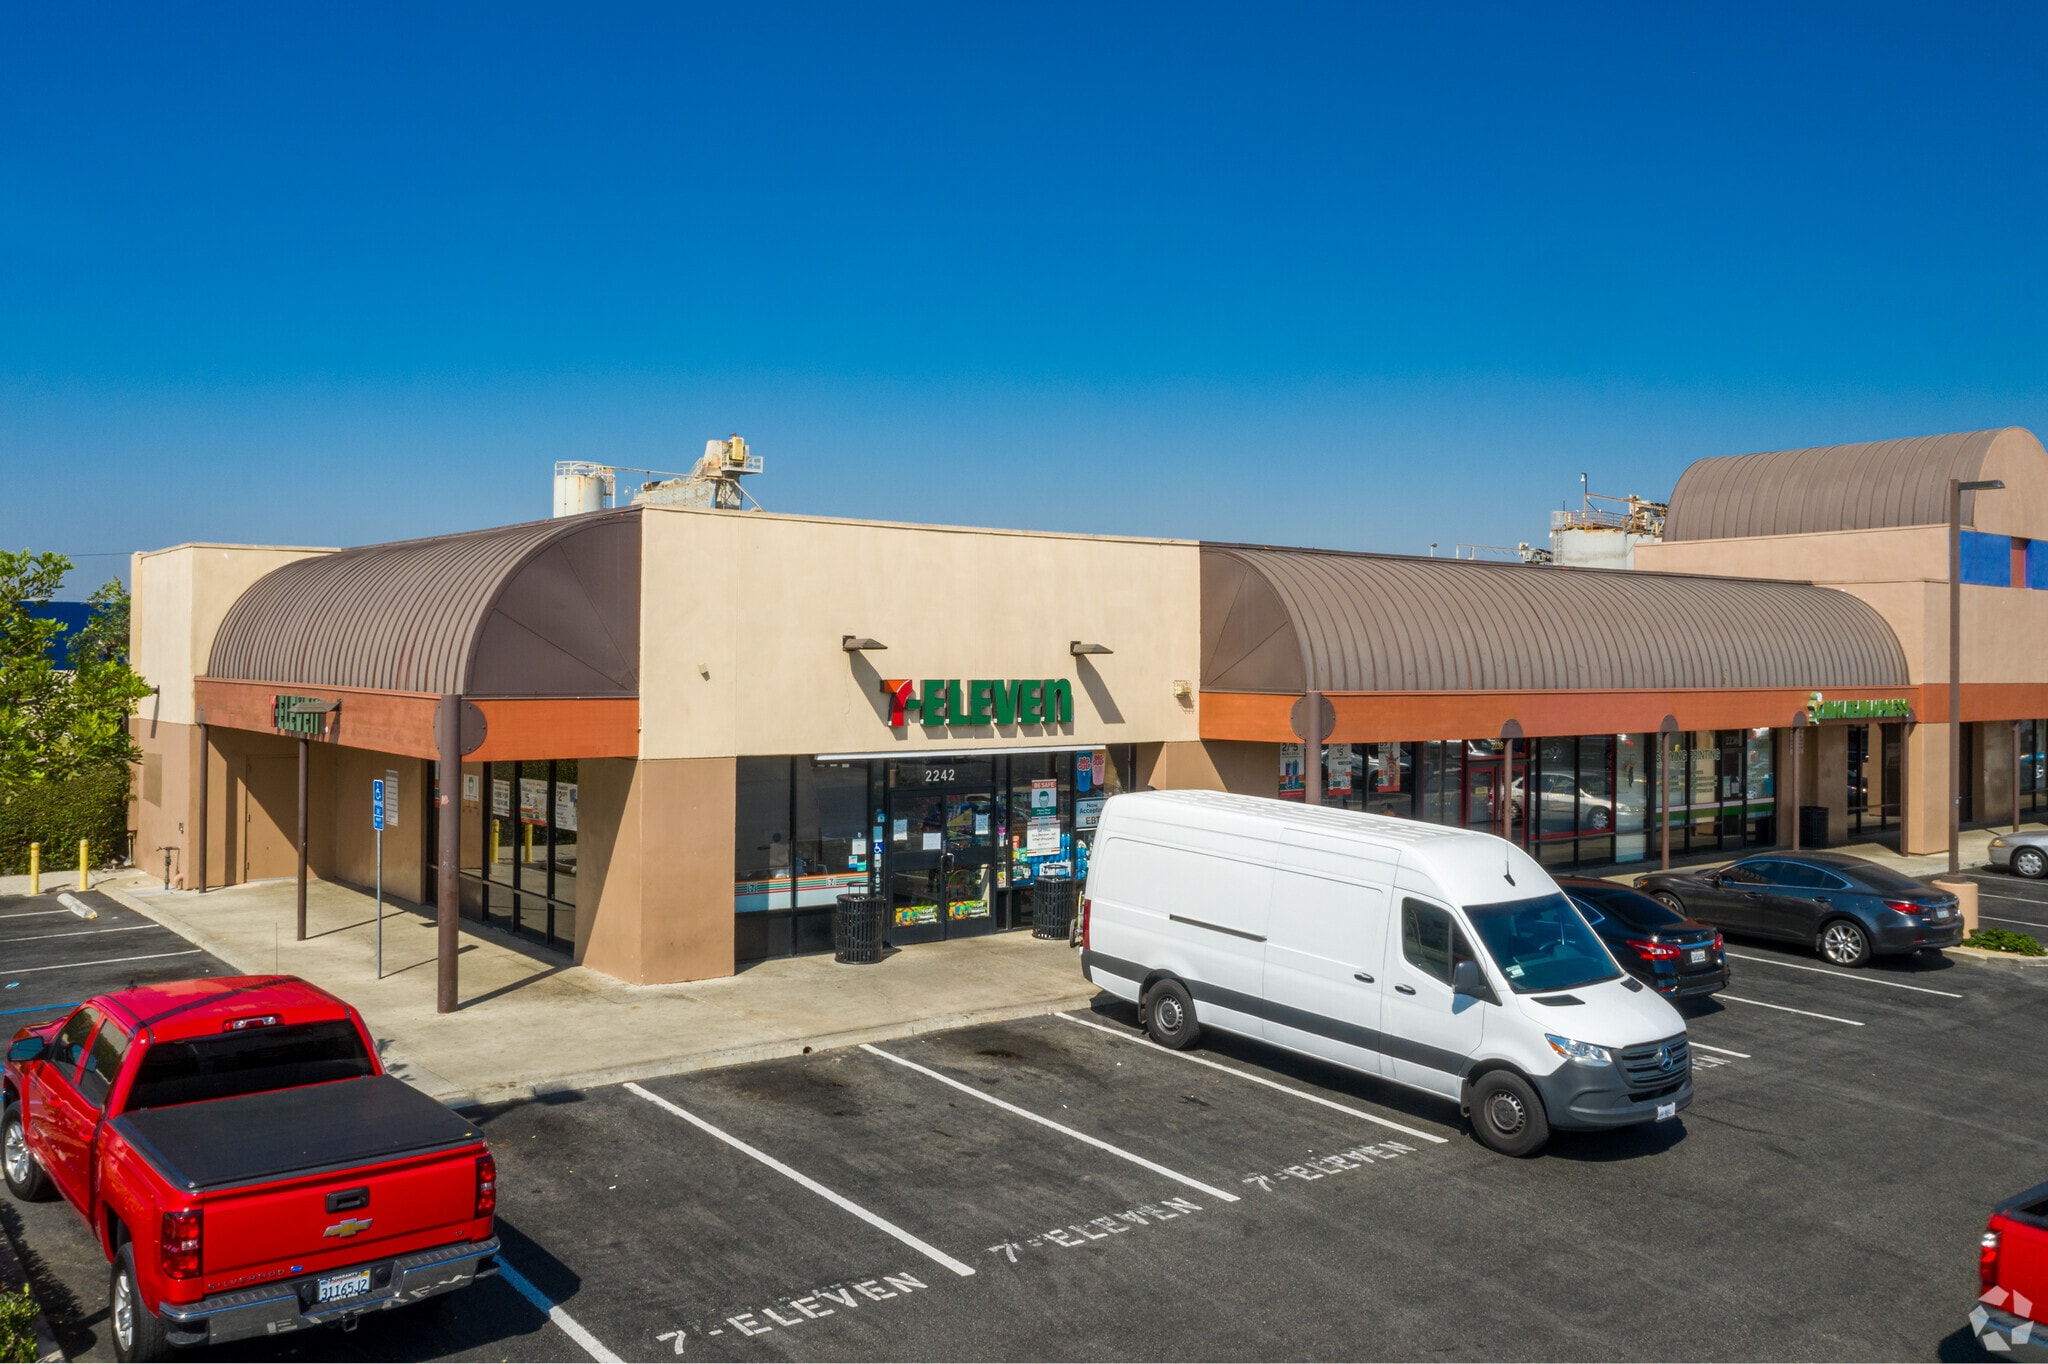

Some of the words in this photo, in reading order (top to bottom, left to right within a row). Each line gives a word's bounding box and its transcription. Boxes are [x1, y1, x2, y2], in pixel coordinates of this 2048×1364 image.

[925, 769, 955, 782] 2242
[321, 1278, 367, 1301] 31165J2
[656, 1272, 928, 1354] 7-ELEVEN
